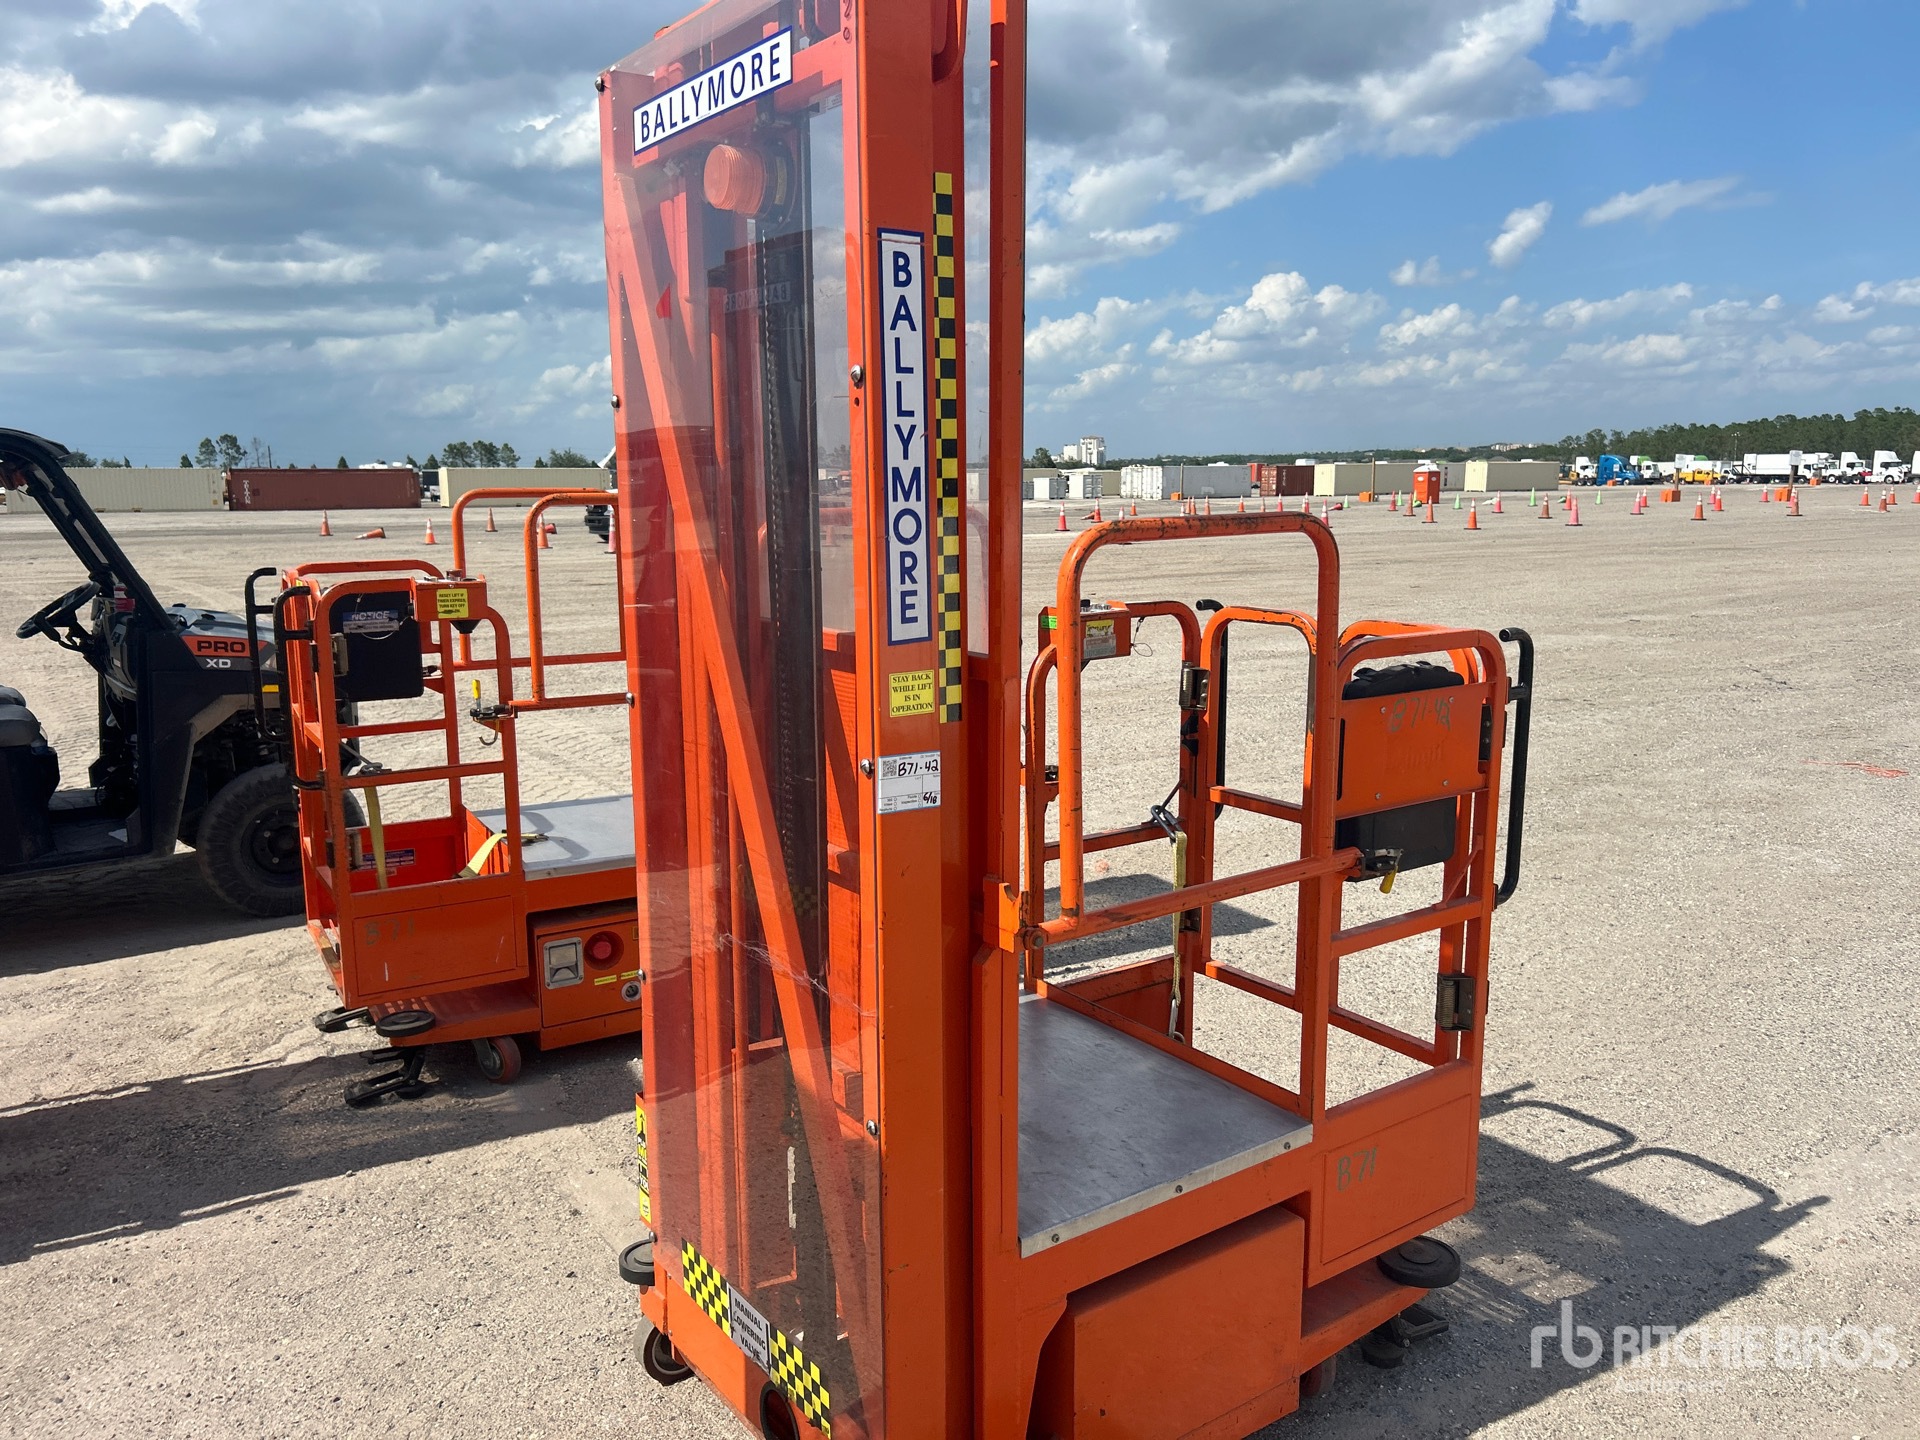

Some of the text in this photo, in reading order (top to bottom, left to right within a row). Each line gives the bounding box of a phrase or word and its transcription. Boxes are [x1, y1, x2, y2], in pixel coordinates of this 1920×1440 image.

[641, 42, 781, 143] BALLYMORE
[890, 251, 922, 625] BALLYMORE
[352, 611, 389, 620] NOTICE
[197, 641, 245, 653] PRO
[206, 658, 231, 668] XD
[892, 673, 931, 683] STAY BACK
[892, 684, 916, 693] WHILE
[892, 702, 933, 713] OPERATION
[1337, 1147, 1377, 1192] B71
[735, 1298, 762, 1331] MANUAL
[734, 1311, 766, 1350] LOWERING
[740, 1334, 761, 1359] VALVE
